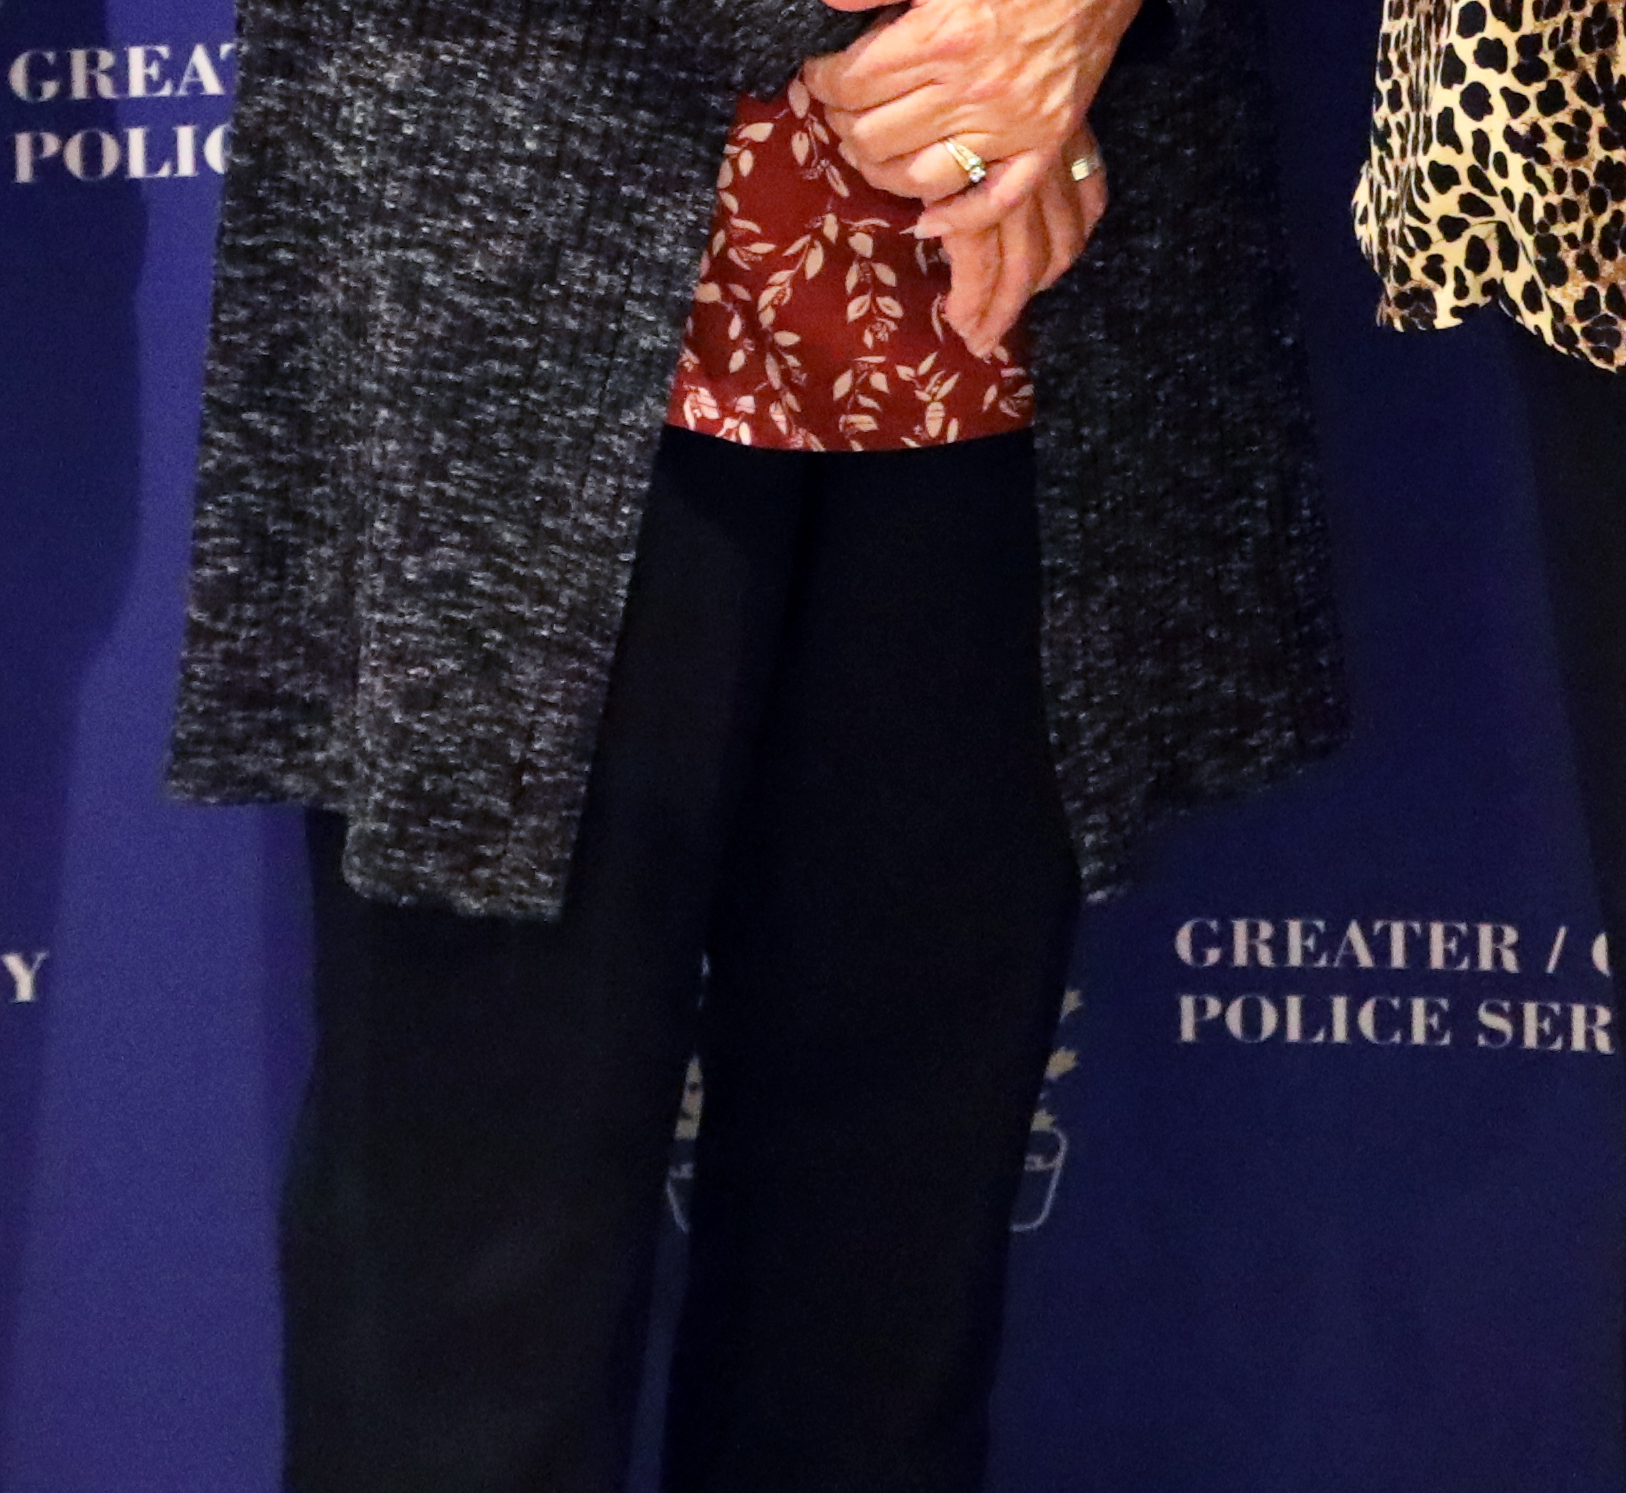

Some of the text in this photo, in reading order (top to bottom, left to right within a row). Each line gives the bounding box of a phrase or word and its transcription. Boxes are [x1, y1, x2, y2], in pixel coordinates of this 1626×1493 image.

[9, 41, 236, 102] GREA
[1174, 917, 1521, 974] GREATER
[1545, 925, 1568, 975] /
[1177, 992, 1452, 1047] POLICE
